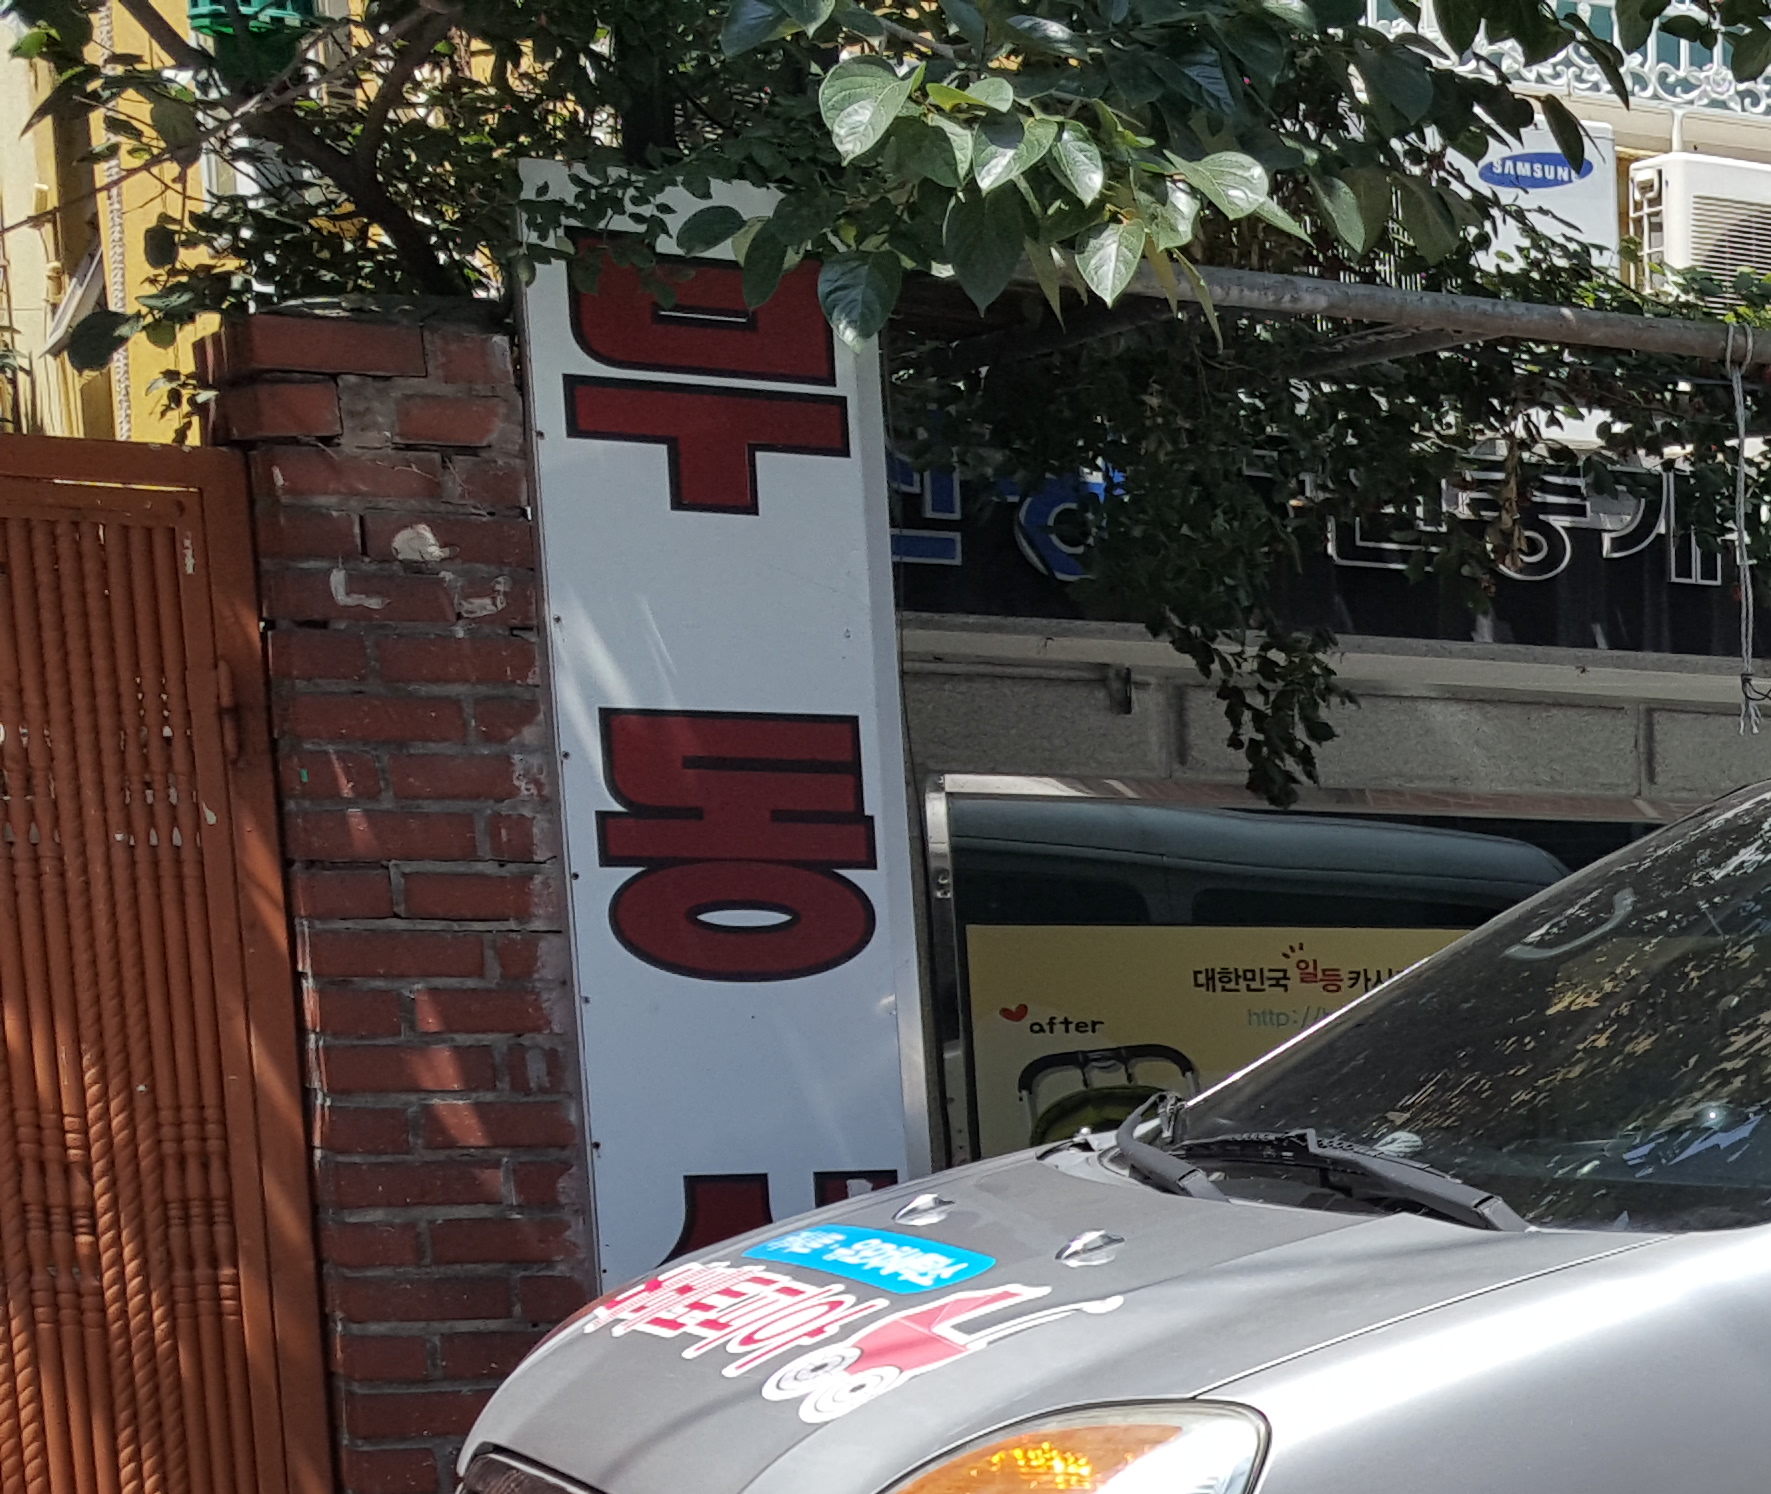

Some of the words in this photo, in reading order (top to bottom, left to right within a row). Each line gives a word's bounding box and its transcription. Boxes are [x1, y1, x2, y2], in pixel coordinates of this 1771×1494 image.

[1491, 157, 1581, 183] SAMSUN
[1192, 967, 1291, 993] 대한민국
[1295, 958, 1344, 994] 일등
[1029, 1016, 1105, 1036] after
